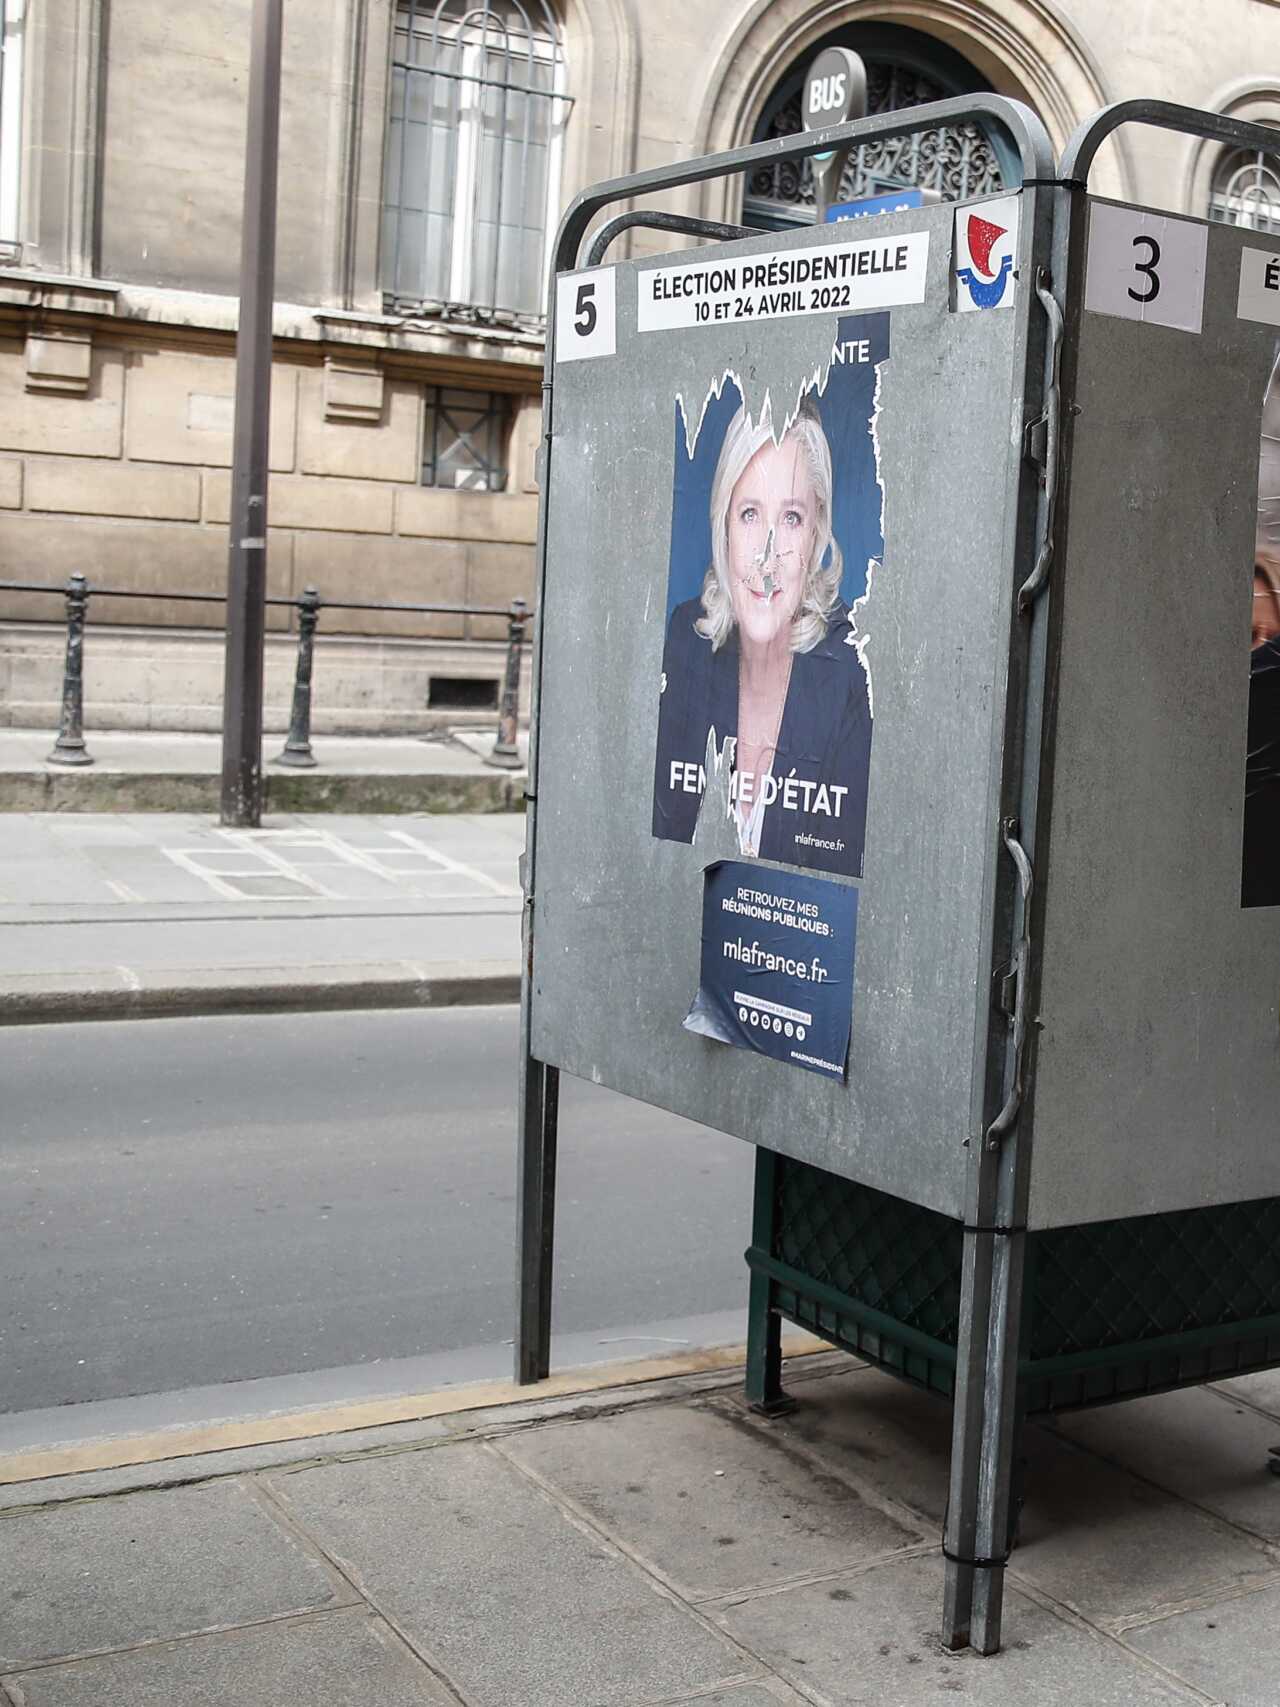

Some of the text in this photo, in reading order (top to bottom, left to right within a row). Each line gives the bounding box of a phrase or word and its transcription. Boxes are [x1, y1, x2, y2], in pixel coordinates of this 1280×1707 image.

[809, 73, 846, 113] BUS
[653, 246, 908, 300] ÉLECTION PRÉSIDENTIELLE
[1128, 236, 1160, 302] 3
[574, 283, 597, 336] 5
[695, 285, 851, 321] 10 ET 24 AVRIL 2022
[722, 897, 771, 921] RÉUNIONS
[773, 911, 829, 936] PUBLIQUES
[737, 887, 819, 918] RETROUVEZ MES
[723, 937, 827, 983] mlafrance.fr
